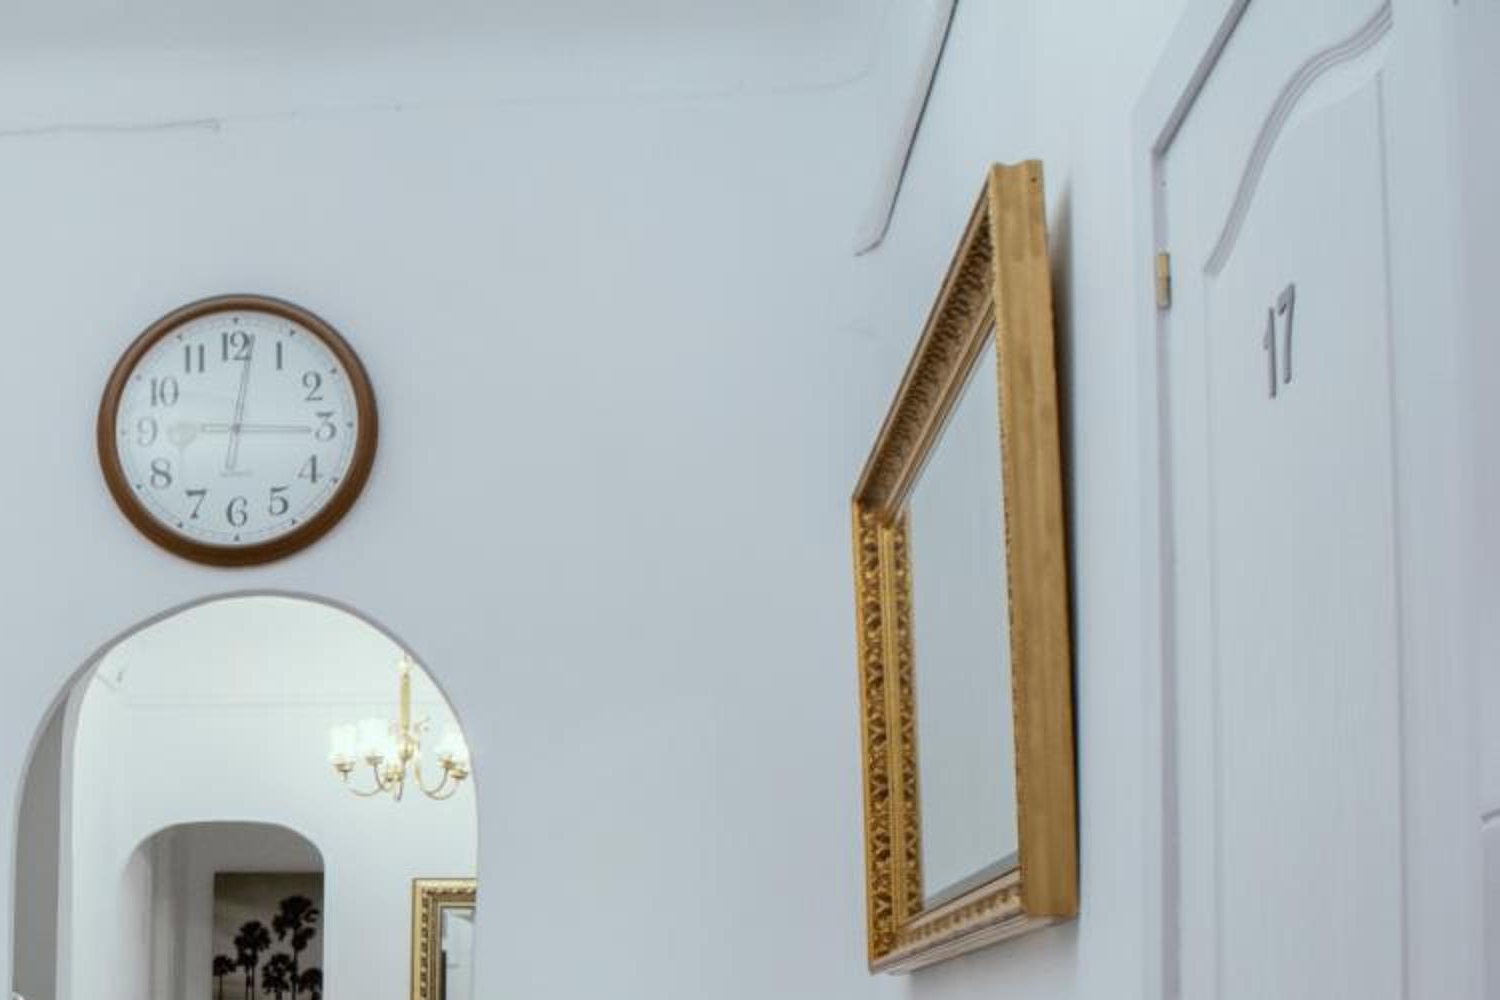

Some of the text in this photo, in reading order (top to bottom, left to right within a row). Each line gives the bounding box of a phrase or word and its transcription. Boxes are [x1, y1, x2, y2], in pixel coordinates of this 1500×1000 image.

[221, 331, 252, 362] 12
[275, 341, 284, 370] 1
[1263, 283, 1296, 398] 17
[184, 344, 205, 373] 11
[150, 376, 179, 407] 10
[302, 371, 323, 401] 2
[137, 417, 158, 447] 9
[314, 412, 337, 442] 3
[150, 458, 173, 488] 8
[298, 454, 324, 484] 4
[185, 489, 207, 519] 7
[226, 497, 248, 527] 6
[268, 486, 290, 516] 5
